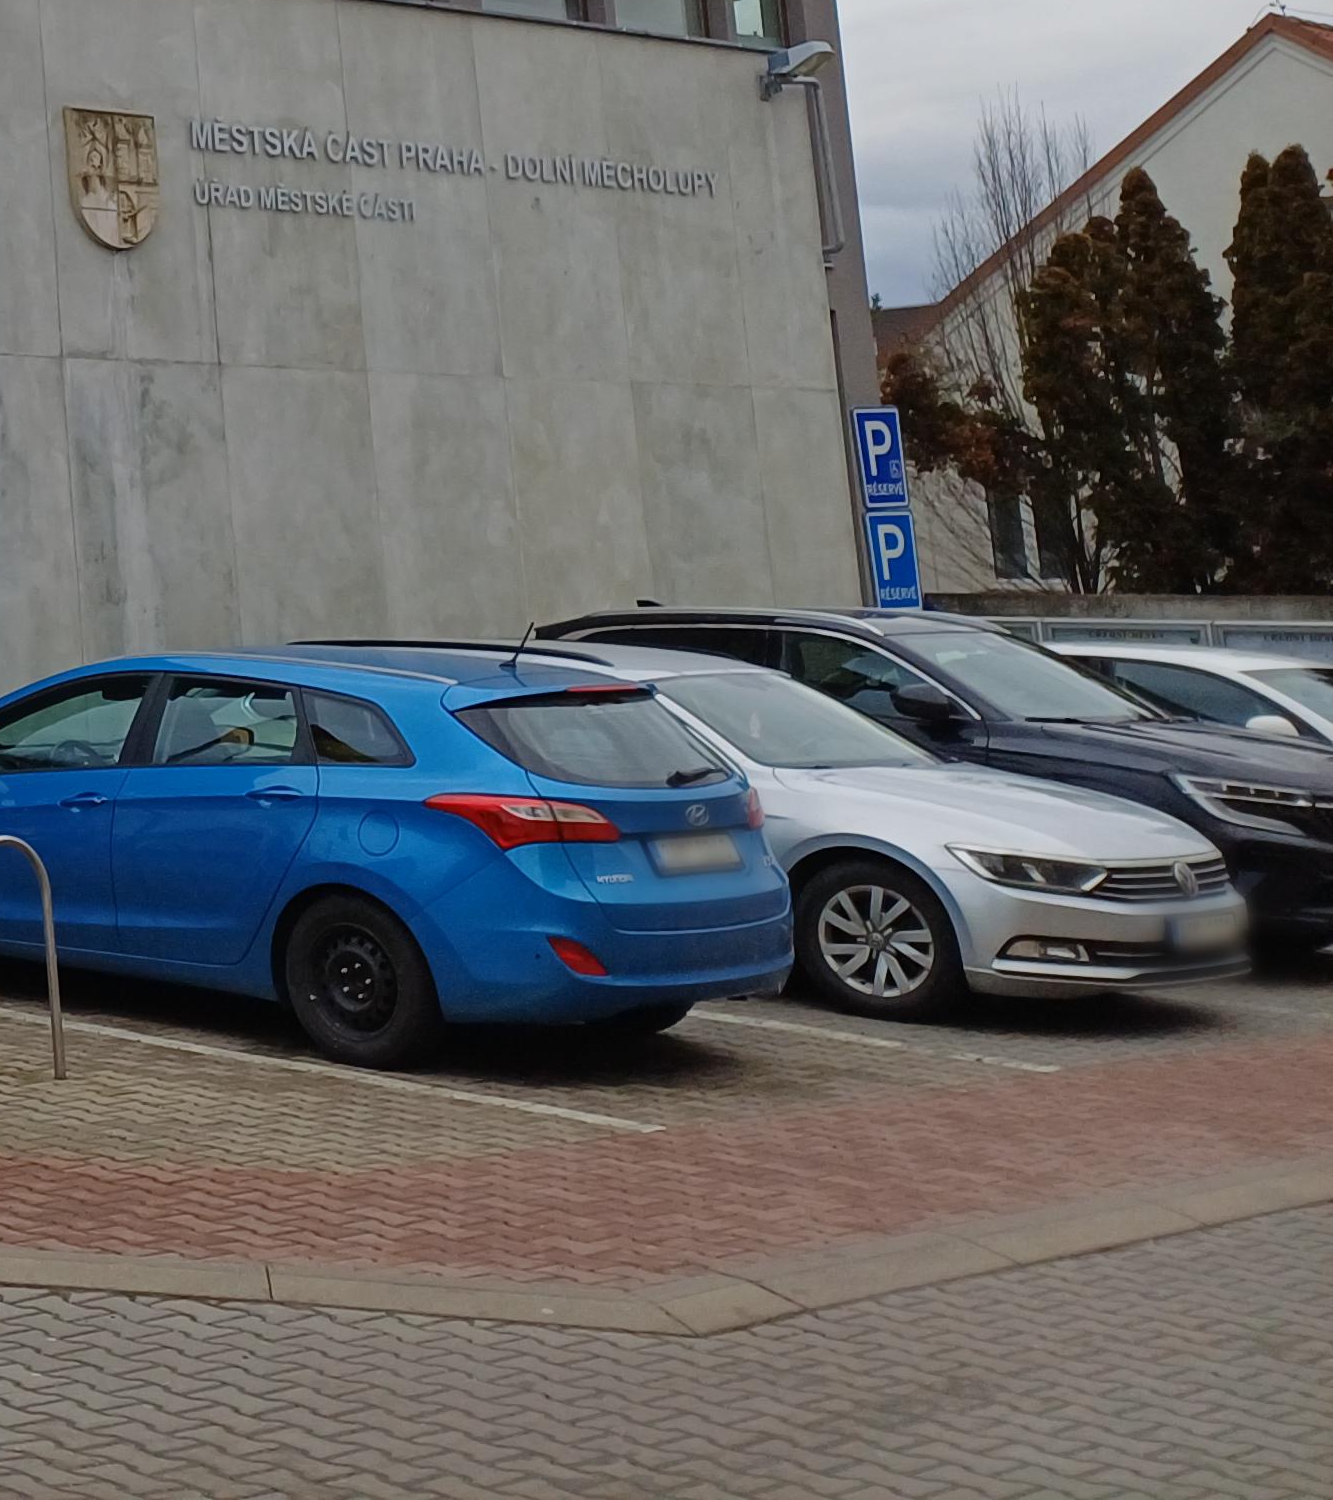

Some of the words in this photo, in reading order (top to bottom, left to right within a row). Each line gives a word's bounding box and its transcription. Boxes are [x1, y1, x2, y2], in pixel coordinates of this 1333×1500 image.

[191, 116, 319, 161] MĚSTSKÁ
[400, 141, 484, 175] PRAHA
[582, 157, 719, 199] MĚCHOLUPY
[194, 178, 254, 209] ÚŘAD
[259, 183, 355, 218] MĚSTSKÉ
[359, 192, 417, 222] ČÁSTI
[864, 420, 893, 477] P
[877, 523, 905, 581] P
